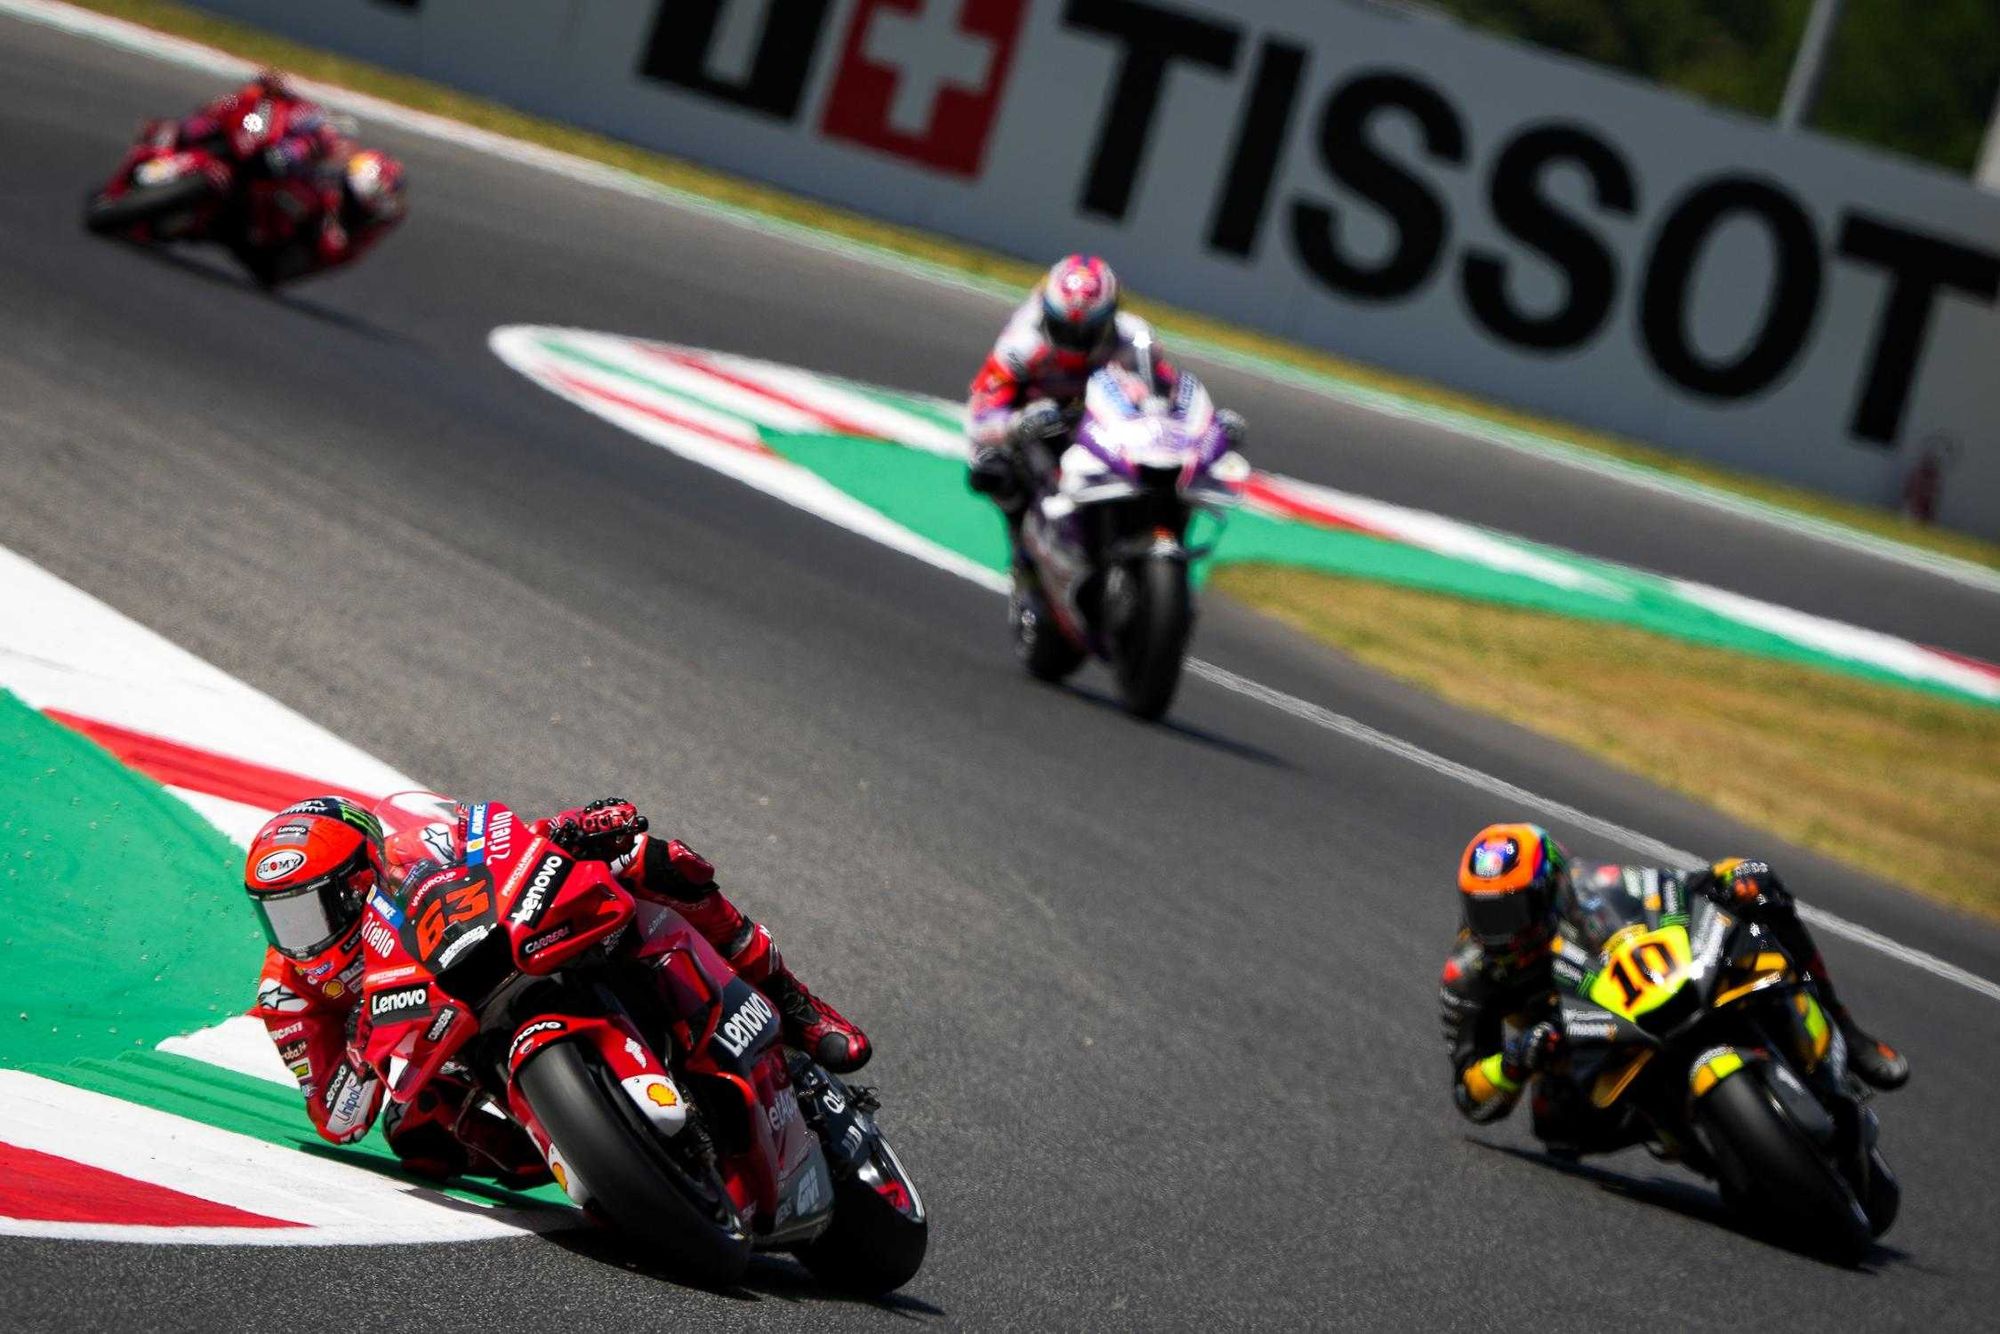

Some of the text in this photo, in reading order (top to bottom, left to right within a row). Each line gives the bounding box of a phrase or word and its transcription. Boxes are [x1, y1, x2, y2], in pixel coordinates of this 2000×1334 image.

[1062, 0, 2000, 447] TISSOT
[416, 880, 489, 961] 63
[512, 854, 563, 922] Lenovo
[371, 988, 427, 1016] Lenovo
[1610, 941, 1677, 1010] 10
[509, 1021, 562, 1060] novo
[714, 992, 773, 1058] Lenovo
